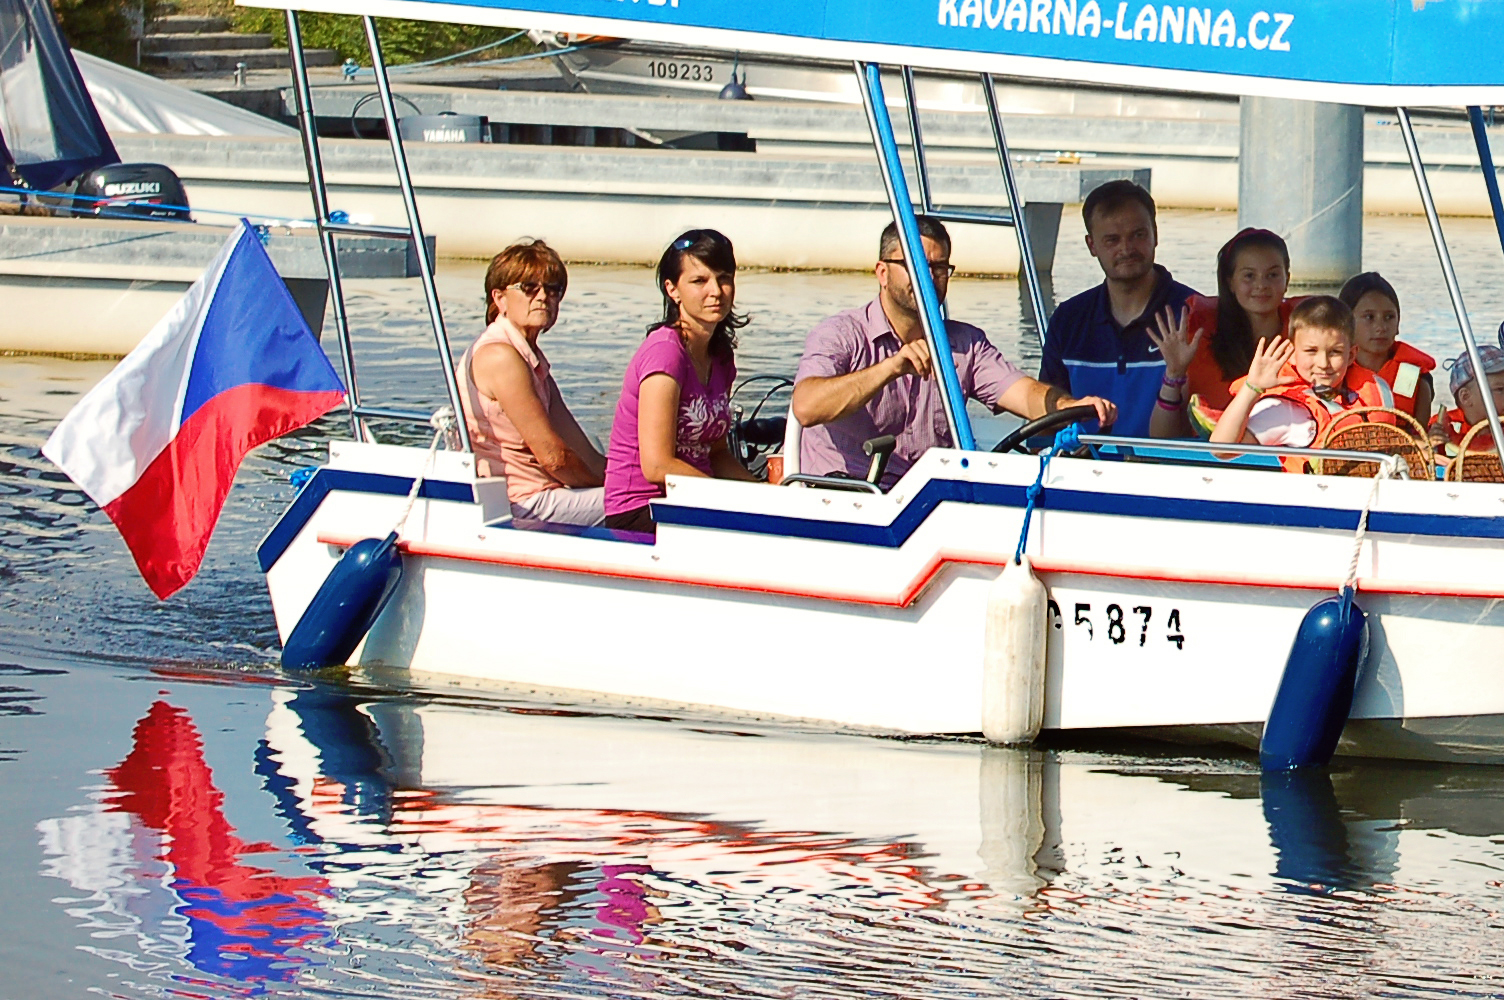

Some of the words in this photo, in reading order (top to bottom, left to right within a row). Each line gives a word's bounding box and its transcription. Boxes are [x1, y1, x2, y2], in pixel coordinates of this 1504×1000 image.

[647, 60, 714, 82] 109233
[423, 128, 466, 143] YAMAHA
[105, 182, 161, 197] SUZUKI
